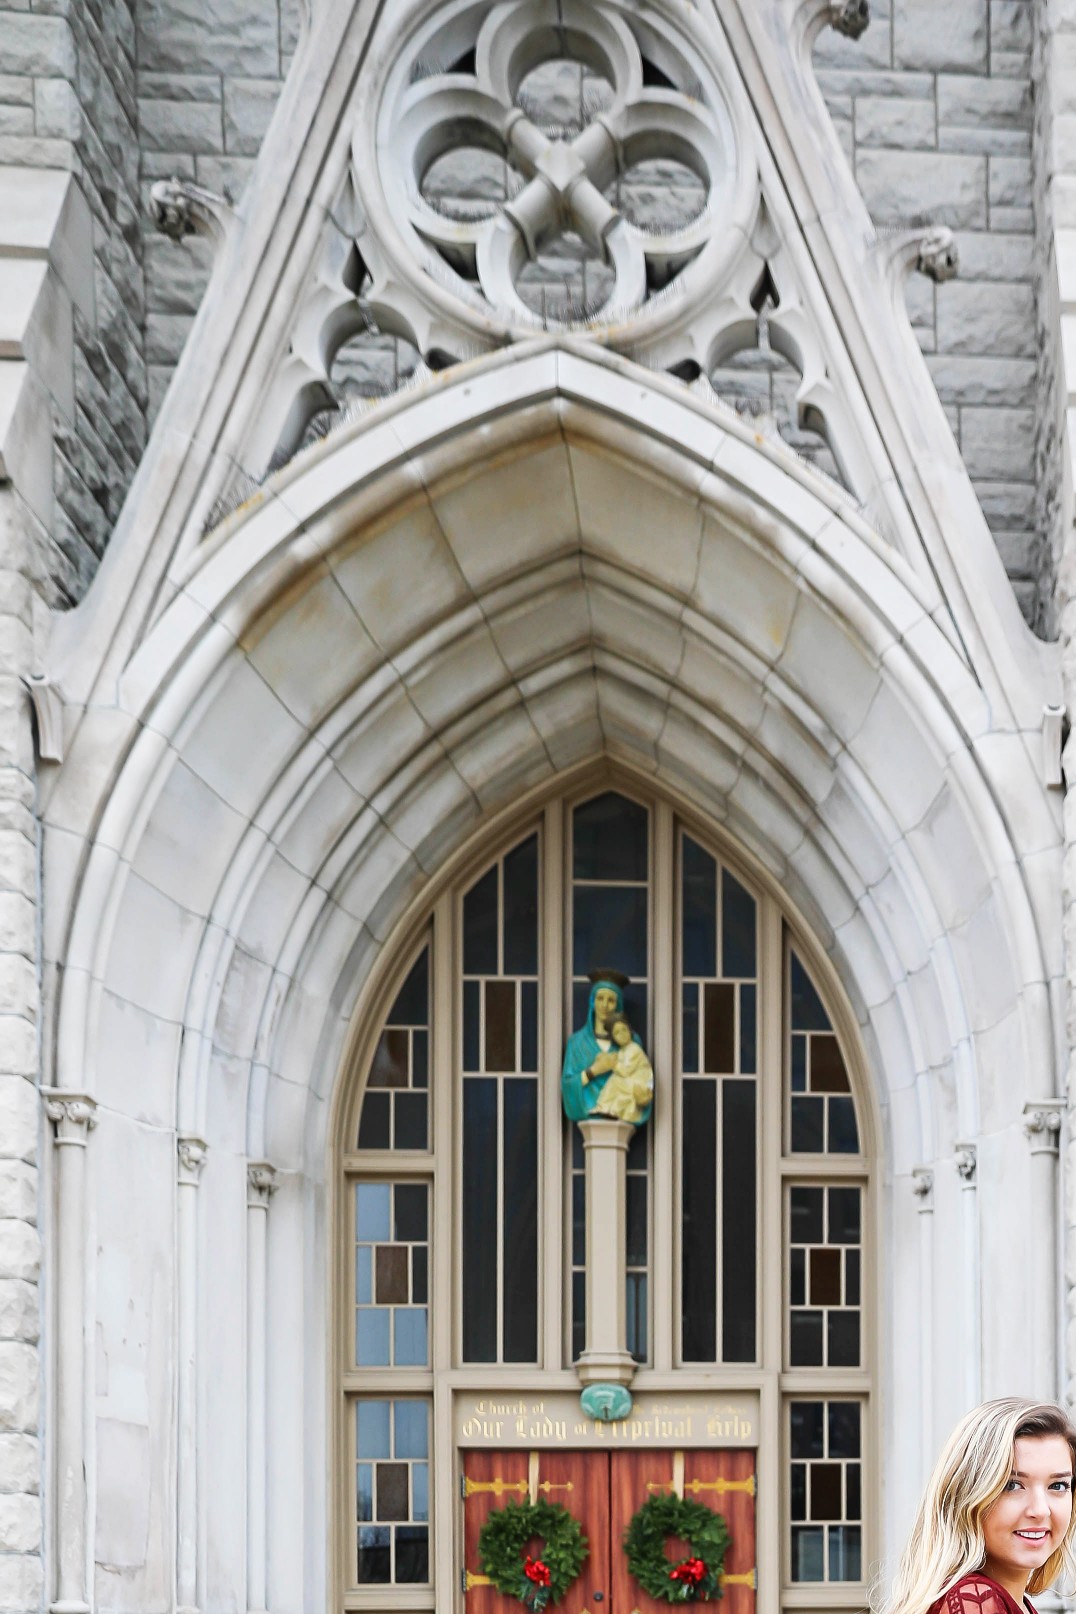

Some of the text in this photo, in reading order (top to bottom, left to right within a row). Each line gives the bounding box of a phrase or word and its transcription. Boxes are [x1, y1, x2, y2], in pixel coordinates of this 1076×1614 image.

[475, 1400, 545, 1417] Church of
[462, 1417, 504, 1439] Our
[515, 1416, 567, 1441] Lady
[574, 1421, 588, 1435] of
[706, 1415, 753, 1441] Help
